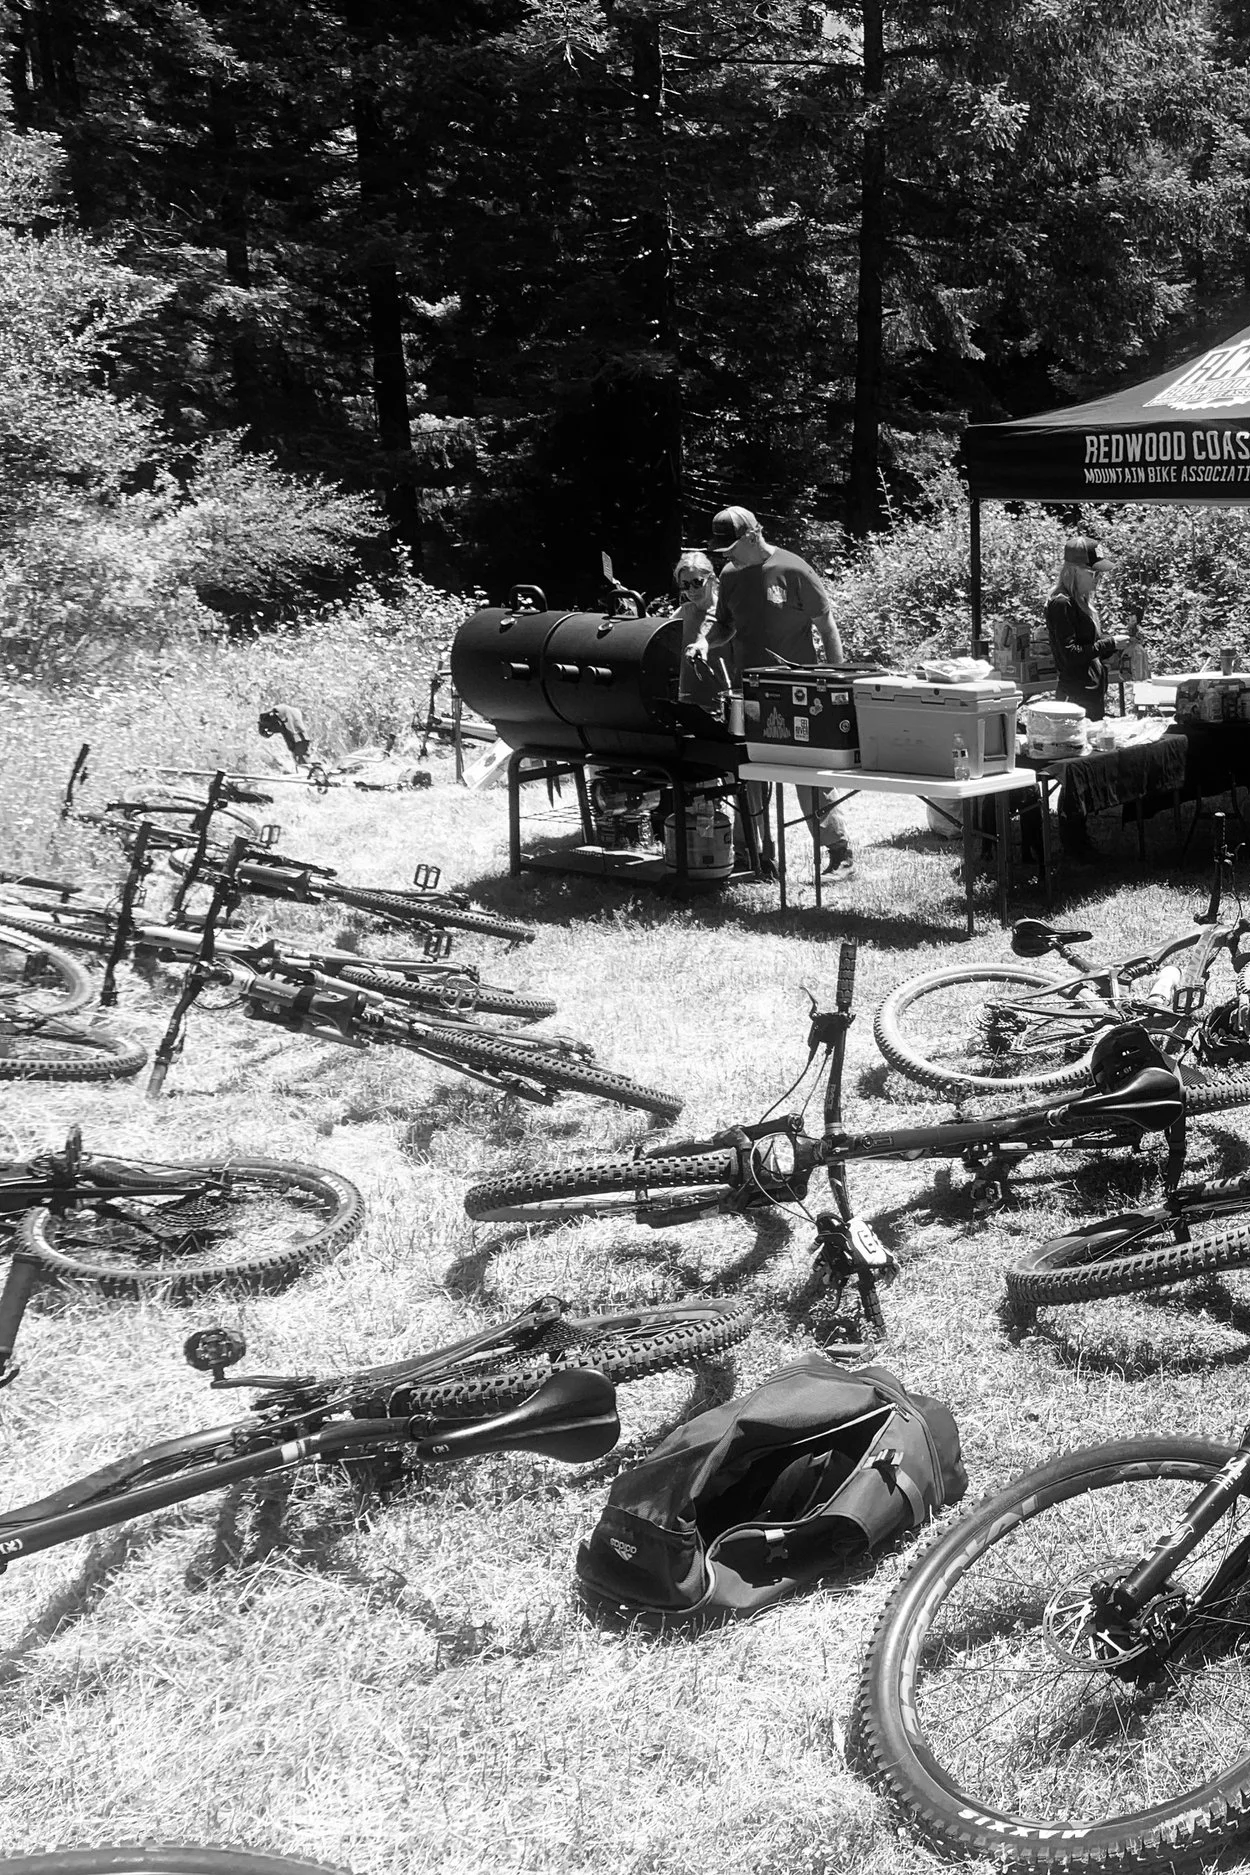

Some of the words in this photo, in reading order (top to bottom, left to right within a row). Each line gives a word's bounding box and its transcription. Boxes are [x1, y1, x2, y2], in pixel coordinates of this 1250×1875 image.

[1085, 432, 1186, 463] REDWOOD
[1084, 467, 1145, 483] MOUNTAIN
[1148, 466, 1177, 483] BIKE
[610, 1537, 638, 1554] adidas
[957, 1809, 1095, 1840] MAXXIS
